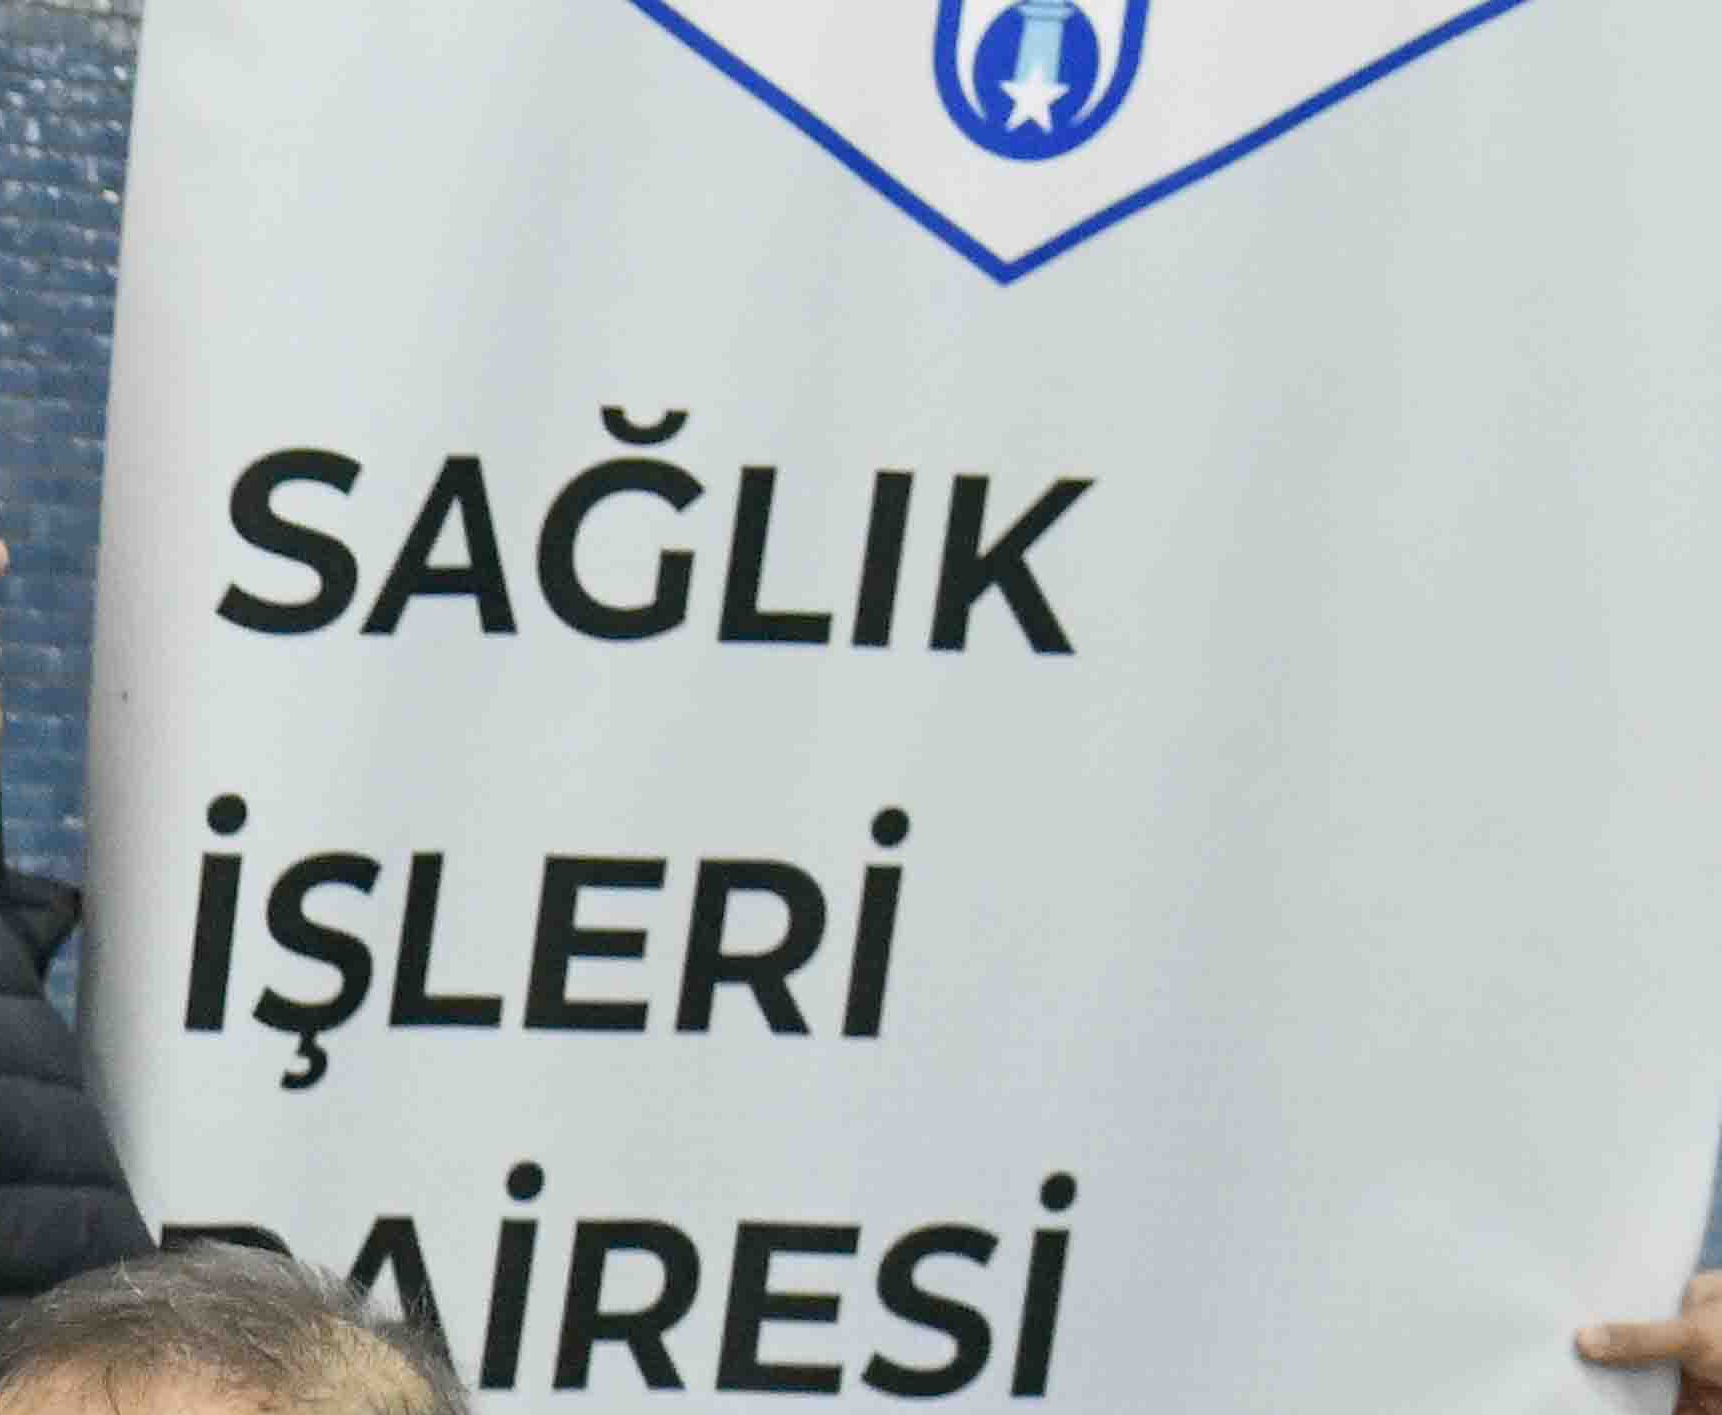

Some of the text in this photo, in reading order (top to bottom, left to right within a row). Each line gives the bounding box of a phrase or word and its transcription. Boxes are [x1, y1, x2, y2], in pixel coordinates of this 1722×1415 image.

[215, 405, 1097, 656] SAĞLIK
[183, 791, 911, 1092] İŞLERİ
[161, 1160, 1080, 1400] AİRESİ
